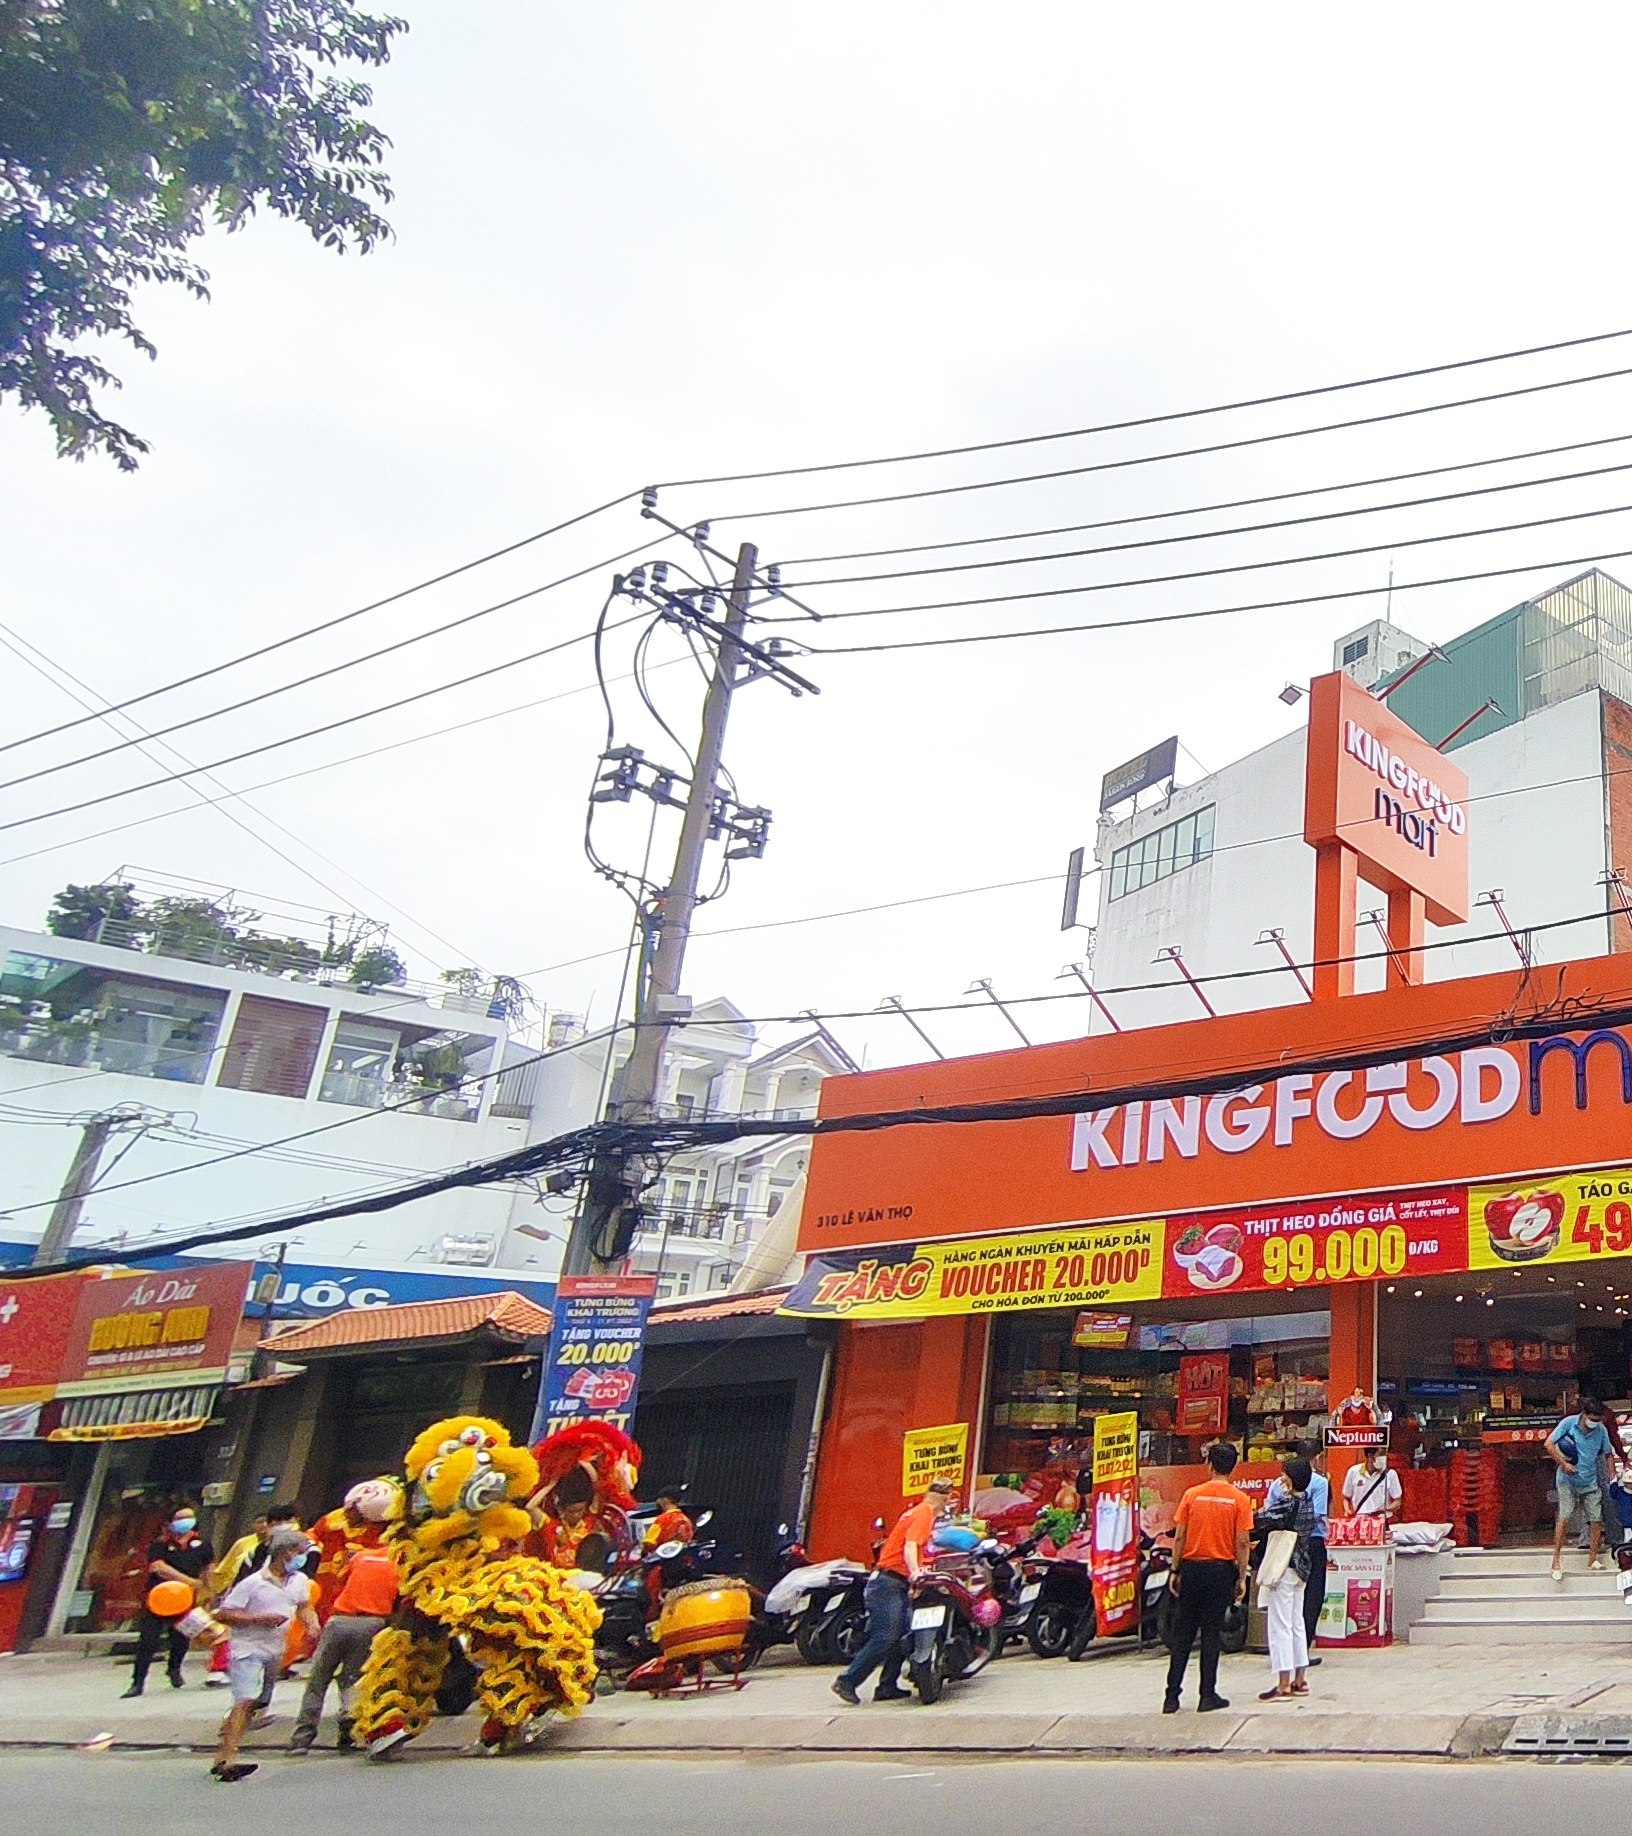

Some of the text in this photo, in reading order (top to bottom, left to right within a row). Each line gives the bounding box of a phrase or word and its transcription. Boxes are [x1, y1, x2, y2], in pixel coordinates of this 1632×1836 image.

[1345, 720, 1466, 836] KINGFOOD
[1374, 787, 1439, 858] mart
[1070, 1045, 1521, 1172] KINGFOOD
[1577, 1180, 1613, 1201] TÁO
[816, 1205, 914, 1228] 310 LÊ VĂN THỌ
[1243, 1201, 1397, 1237] THỊT HEO ĐỒNG GIÁ
[943, 1248, 977, 1265] HÀNG
[978, 1244, 1015, 1262] NGÀN
[1015, 1238, 1065, 1258] KHUYẾN
[1066, 1235, 1091, 1253] MÃI
[1122, 1228, 1151, 1247] DẪN
[1262, 1224, 1407, 1286] 99.000
[813, 1257, 934, 1312] TẶNG
[939, 1257, 1047, 1299] VOUCHER
[971, 1297, 994, 1310] CHO
[995, 1293, 1020, 1308] HÓA
[1021, 1292, 1047, 1307] ĐƠN
[1047, 1289, 1062, 1305] TỪ
[593, 1327, 643, 1340] VOUCHER
[1327, 1429, 1385, 1446] Neptune
[1233, 1478, 1263, 1489] HÀNG
